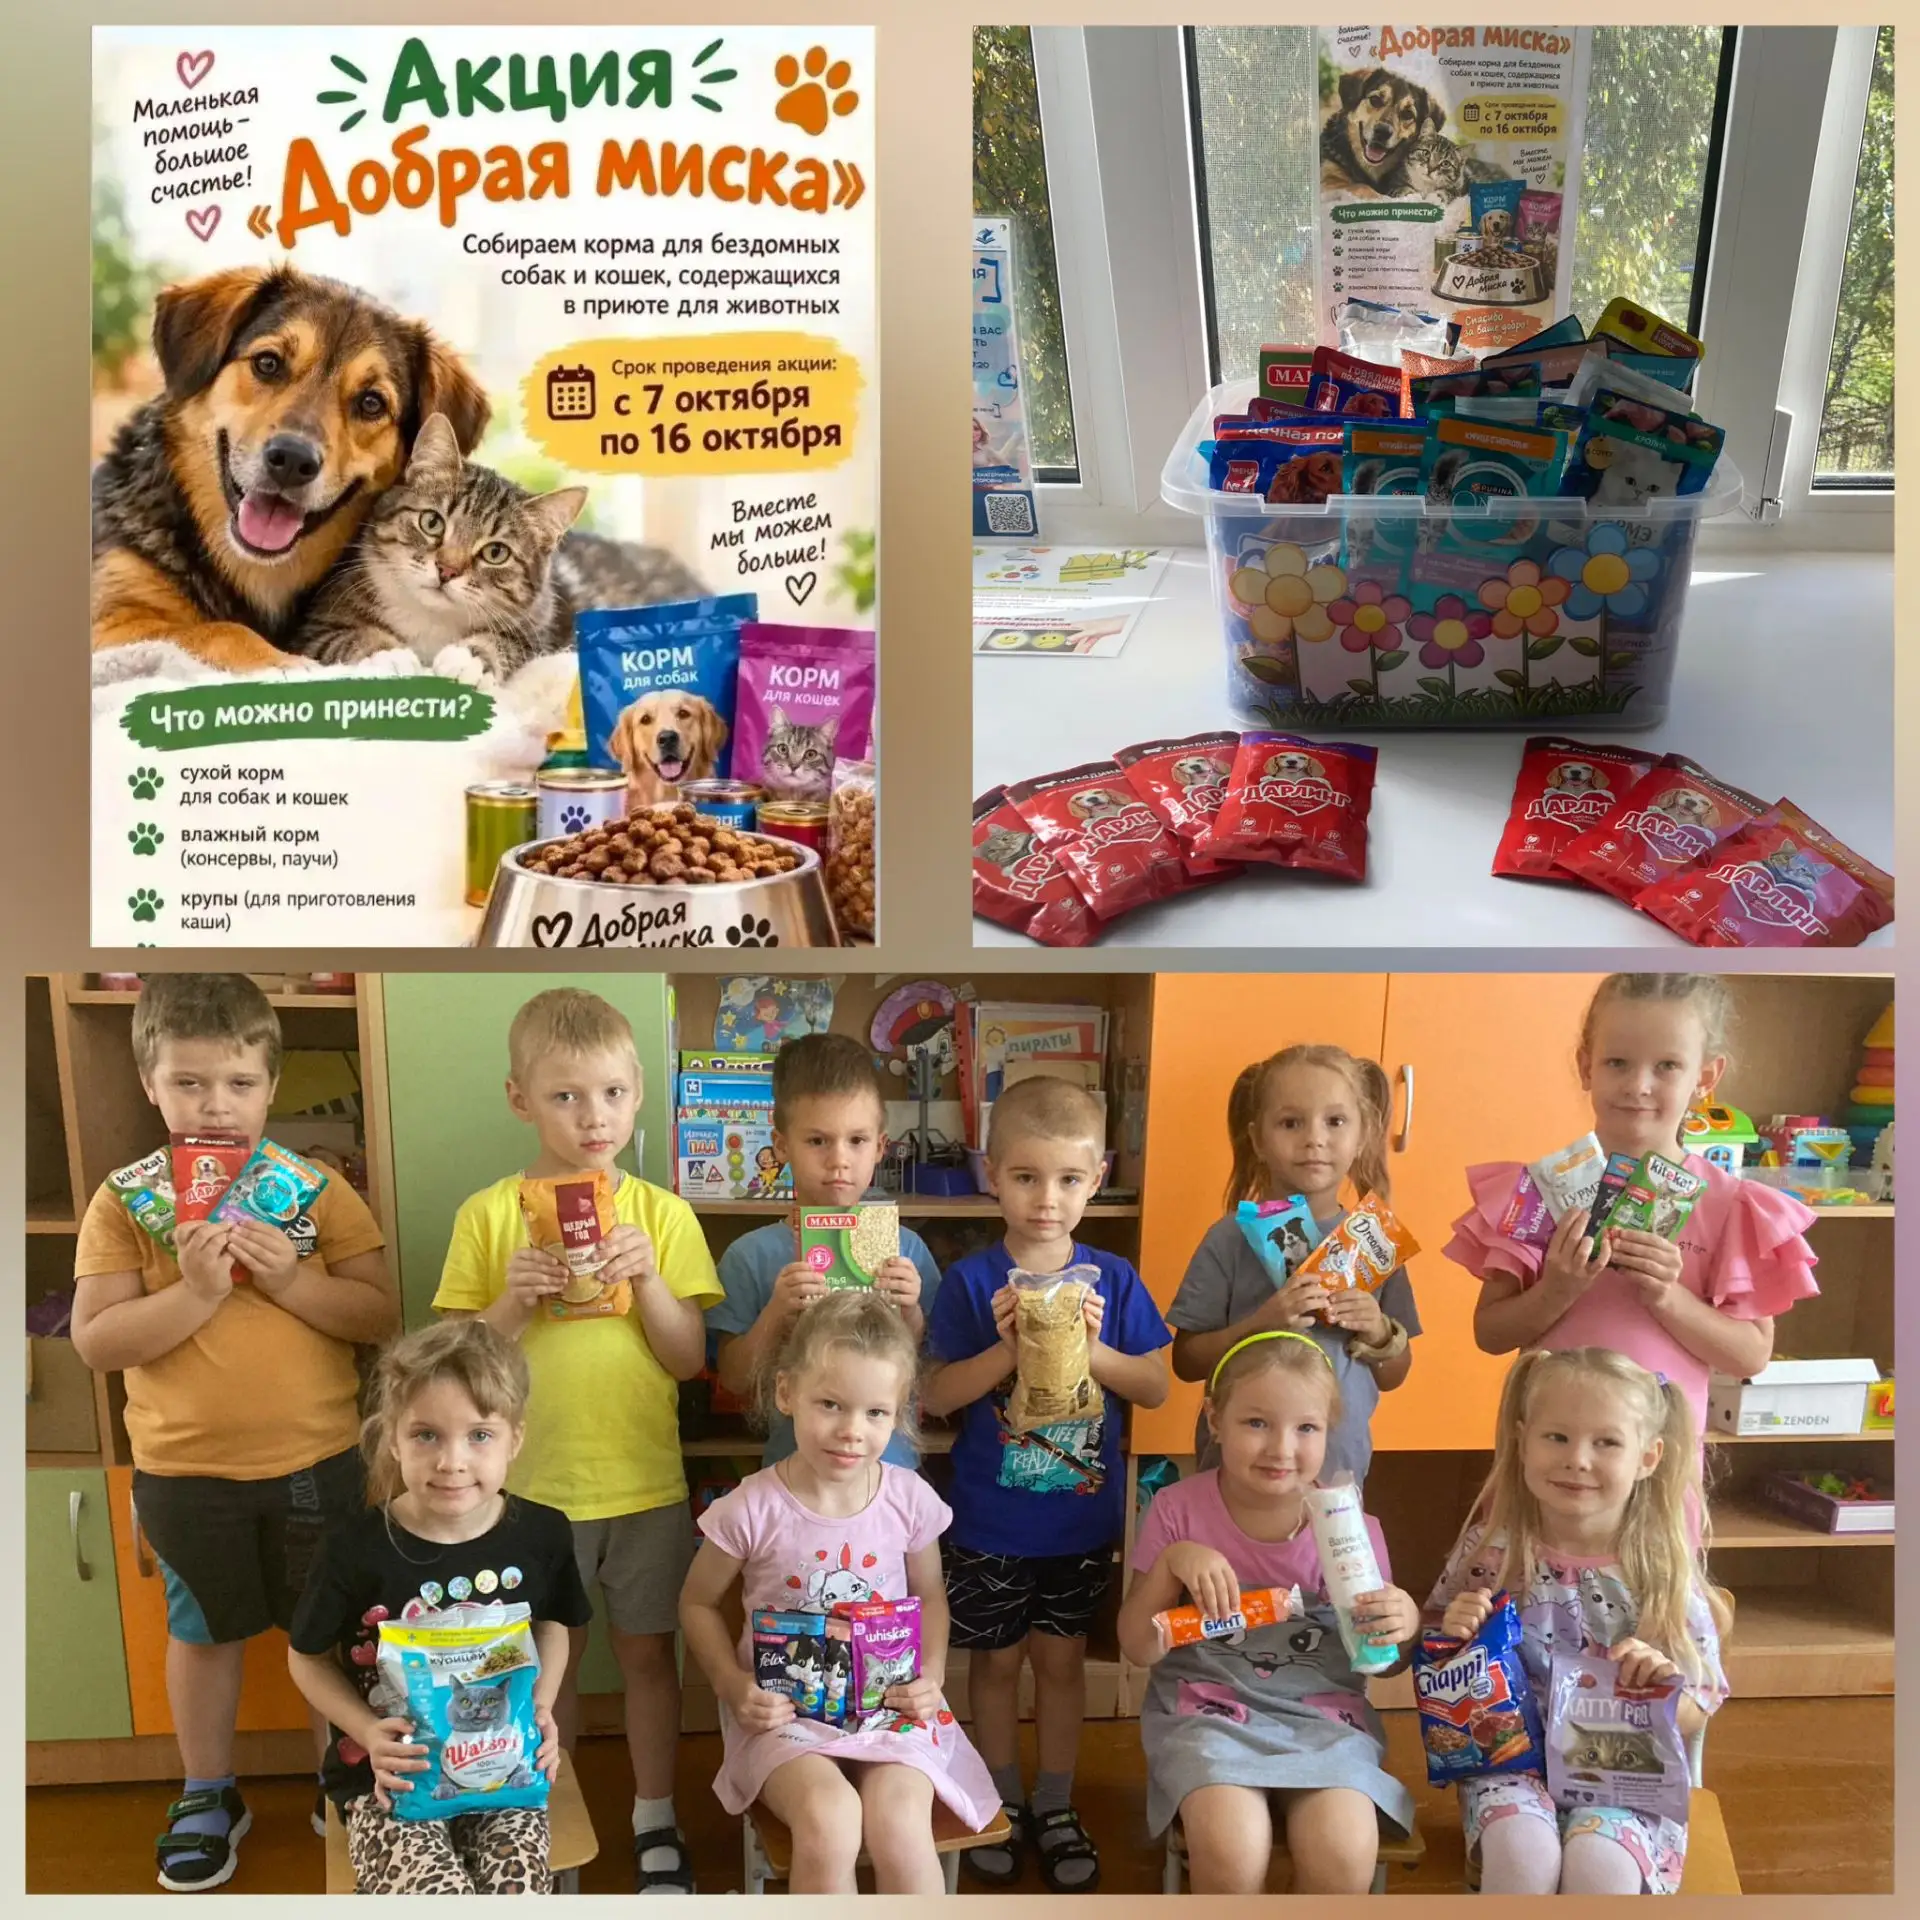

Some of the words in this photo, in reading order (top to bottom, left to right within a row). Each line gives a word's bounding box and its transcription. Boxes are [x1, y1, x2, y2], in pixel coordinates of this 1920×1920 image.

[382, 36, 672, 123] Акция
[132, 86, 260, 122] Маленькая
[1484, 113, 1491, 121] с
[1495, 110, 1502, 121] 7
[1504, 110, 1548, 122] октября
[1480, 125, 1493, 134] по
[1496, 124, 1510, 134] 16
[1512, 125, 1558, 136] октября
[154, 142, 250, 174] большое
[150, 165, 253, 204] счастье!
[247, 124, 570, 249] «Добрая
[597, 138, 866, 214] миска»
[1338, 208, 1357, 219] Что
[1361, 208, 1388, 218] можно
[1391, 207, 1438, 218] принести?
[463, 232, 576, 258] Собираем
[584, 237, 654, 258] корма
[663, 238, 703, 258] для
[712, 232, 840, 258] бездомных
[501, 264, 567, 285] собак
[574, 269, 587, 285] и
[595, 269, 672, 288] кошек,
[679, 269, 840, 289] содержащихся
[1465, 272, 1500, 289] Добрая
[564, 300, 576, 314] в
[584, 299, 669, 318] приюте
[678, 300, 719, 318] для
[727, 299, 840, 315] животных
[1464, 312, 1504, 326] Спасибо
[1463, 327, 1474, 338] за
[1500, 319, 1530, 335] добро!
[612, 359, 656, 379] Срок
[662, 359, 771, 376] проведения
[777, 358, 838, 375] акции:
[614, 394, 631, 416] с
[643, 385, 664, 415] 7
[675, 379, 811, 416] октября
[601, 433, 639, 455] по
[651, 423, 691, 454] 16
[702, 417, 842, 456] октября
[731, 492, 818, 524] Вместе
[710, 530, 744, 550] мы
[755, 512, 832, 543] можем
[737, 538, 827, 576] больше!
[621, 645, 695, 673] КОРМ
[622, 676, 651, 691] для
[655, 670, 699, 686] собак
[769, 664, 841, 691] КОРМ
[762, 689, 792, 703] для
[795, 692, 841, 707] кошек
[150, 705, 205, 735] Что
[214, 701, 315, 728] можно
[323, 694, 474, 730] принести?
[180, 764, 232, 784] сухой
[237, 767, 286, 784] корм
[180, 791, 213, 808] для
[218, 789, 271, 806] собак
[276, 792, 287, 806] и
[292, 792, 350, 807] кошек
[1240, 784, 1352, 808] ДАРЛИНГ
[181, 825, 267, 844] влажный
[273, 830, 320, 847] корм
[180, 849, 278, 870] (консервы,
[282, 849, 340, 870] паучи)
[181, 893, 238, 911] крупы
[244, 889, 282, 910] (для
[287, 891, 416, 911] приготовления
[1705, 863, 1830, 937] ДАРЛИНГ
[181, 912, 232, 933] каши)
[576, 901, 687, 947] Добрая
[1007, 1032, 1073, 1055] ПИРАТЫ
[115, 1155, 165, 1187] kitekat
[1650, 1157, 1696, 1193] kitekat
[562, 1215, 597, 1233] ЩЕДРЫЙ
[810, 1217, 854, 1227] MAKFA
[574, 1229, 590, 1241] ГОД
[1352, 1218, 1392, 1267] Dreamies
[1783, 1415, 1830, 1426] ZENDEN
[1044, 1426, 1076, 1443] LIFE
[1010, 1448, 1065, 1475] READY?
[1204, 1614, 1241, 1632] БИНТ
[864, 1627, 914, 1643] whiskas
